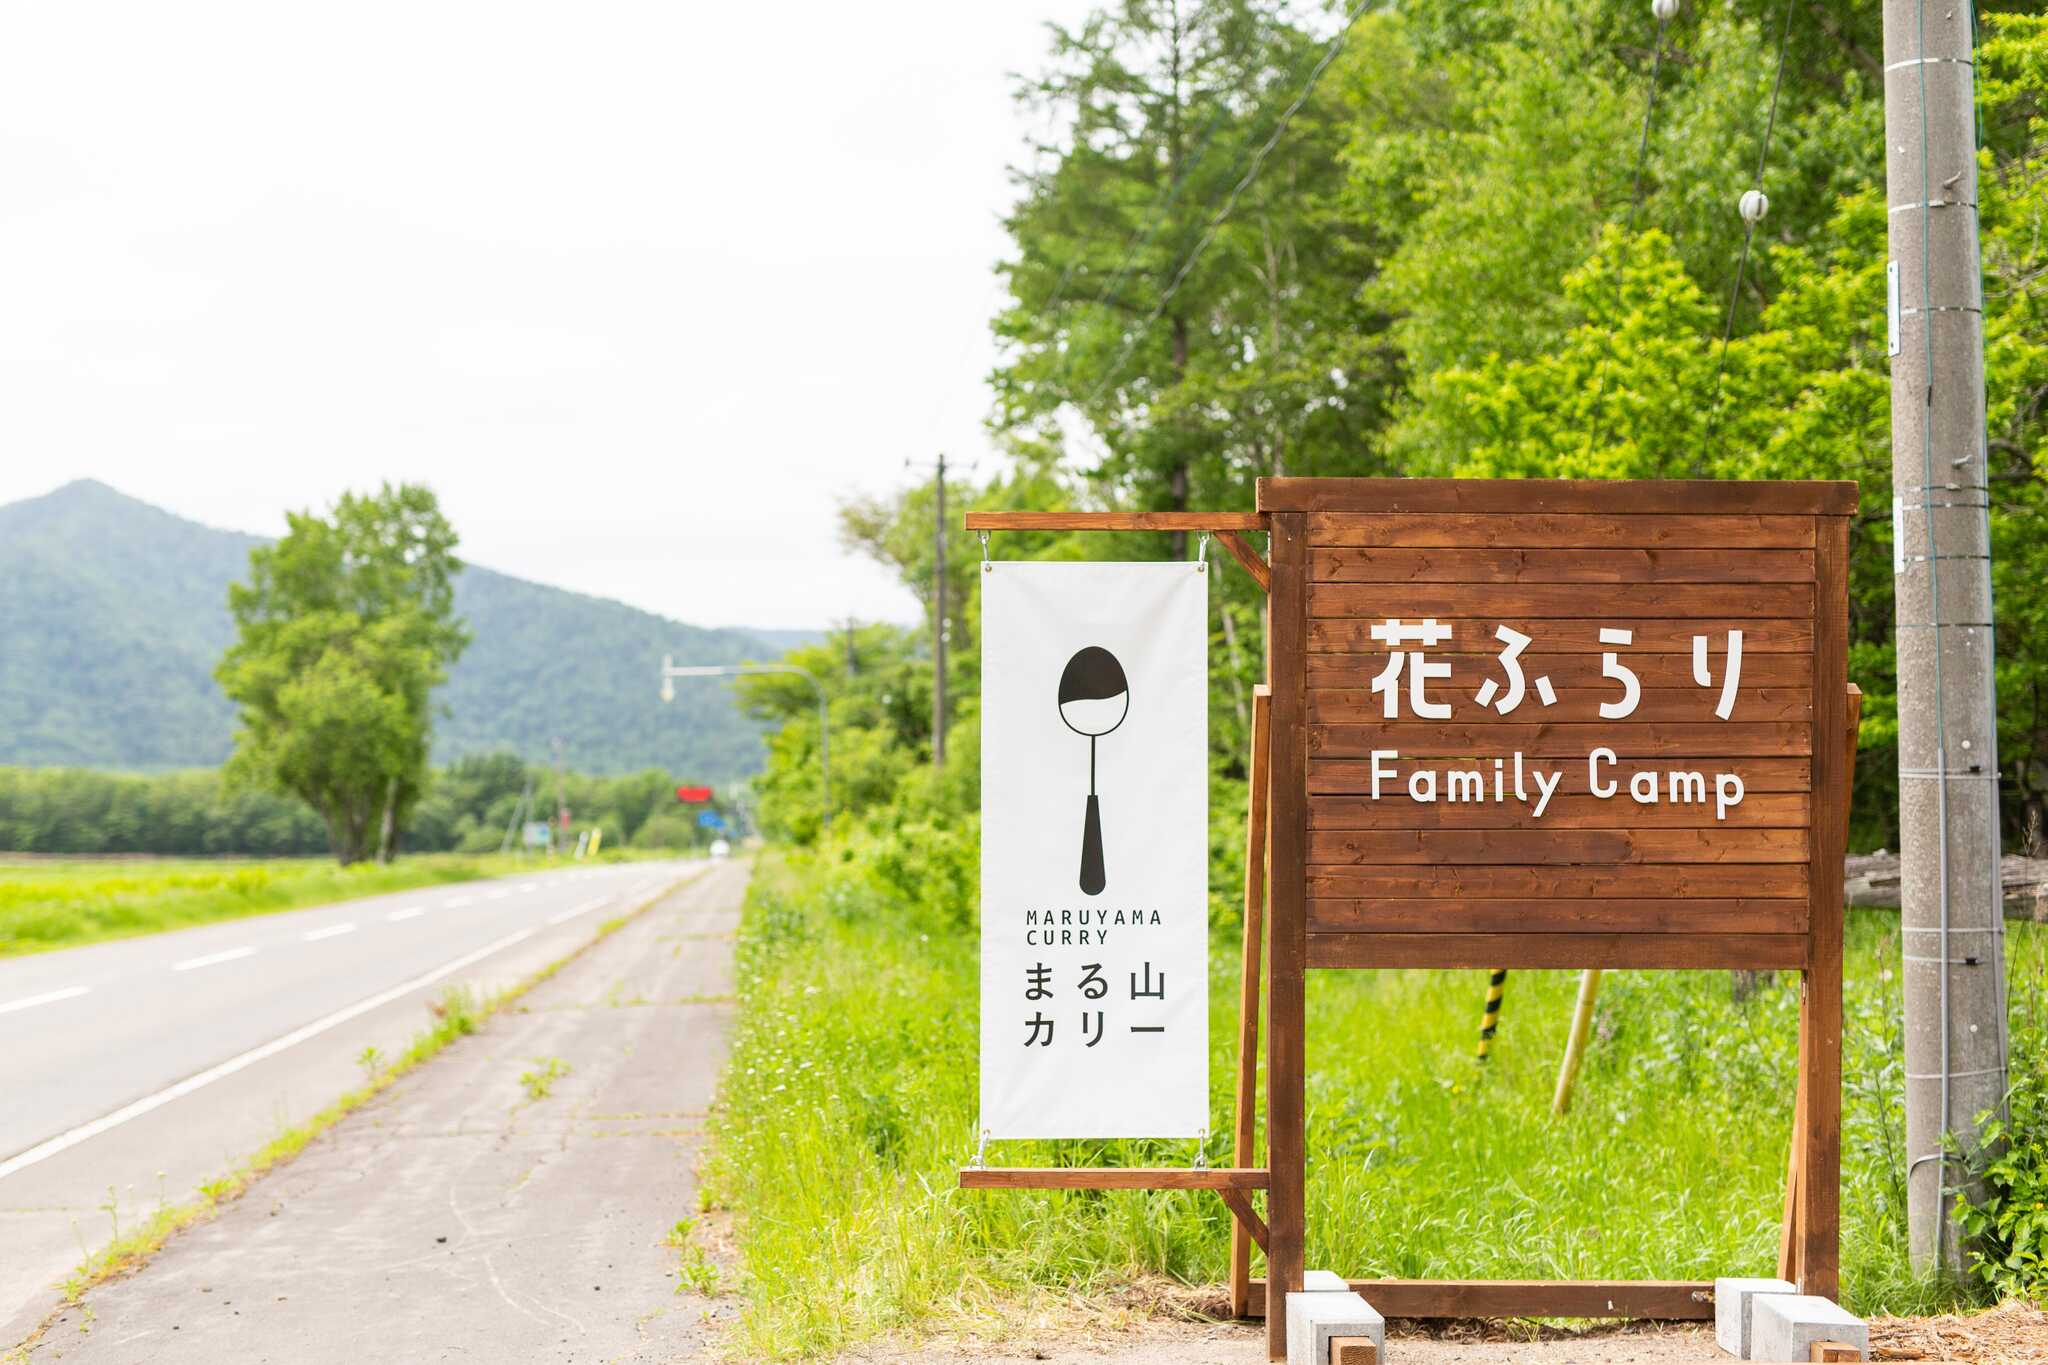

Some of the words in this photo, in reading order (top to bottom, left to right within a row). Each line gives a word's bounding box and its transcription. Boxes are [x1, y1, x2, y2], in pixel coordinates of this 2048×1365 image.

[1371, 619, 1743, 721] 花ふらり
[1372, 750, 1562, 817] Family
[1589, 748, 1745, 819] Camp
[1026, 909, 1161, 926] MARUYAMA
[1026, 930, 1108, 946] CURRY
[1025, 961, 1165, 1001] まる山
[1023, 1010, 1165, 1048] カリー
